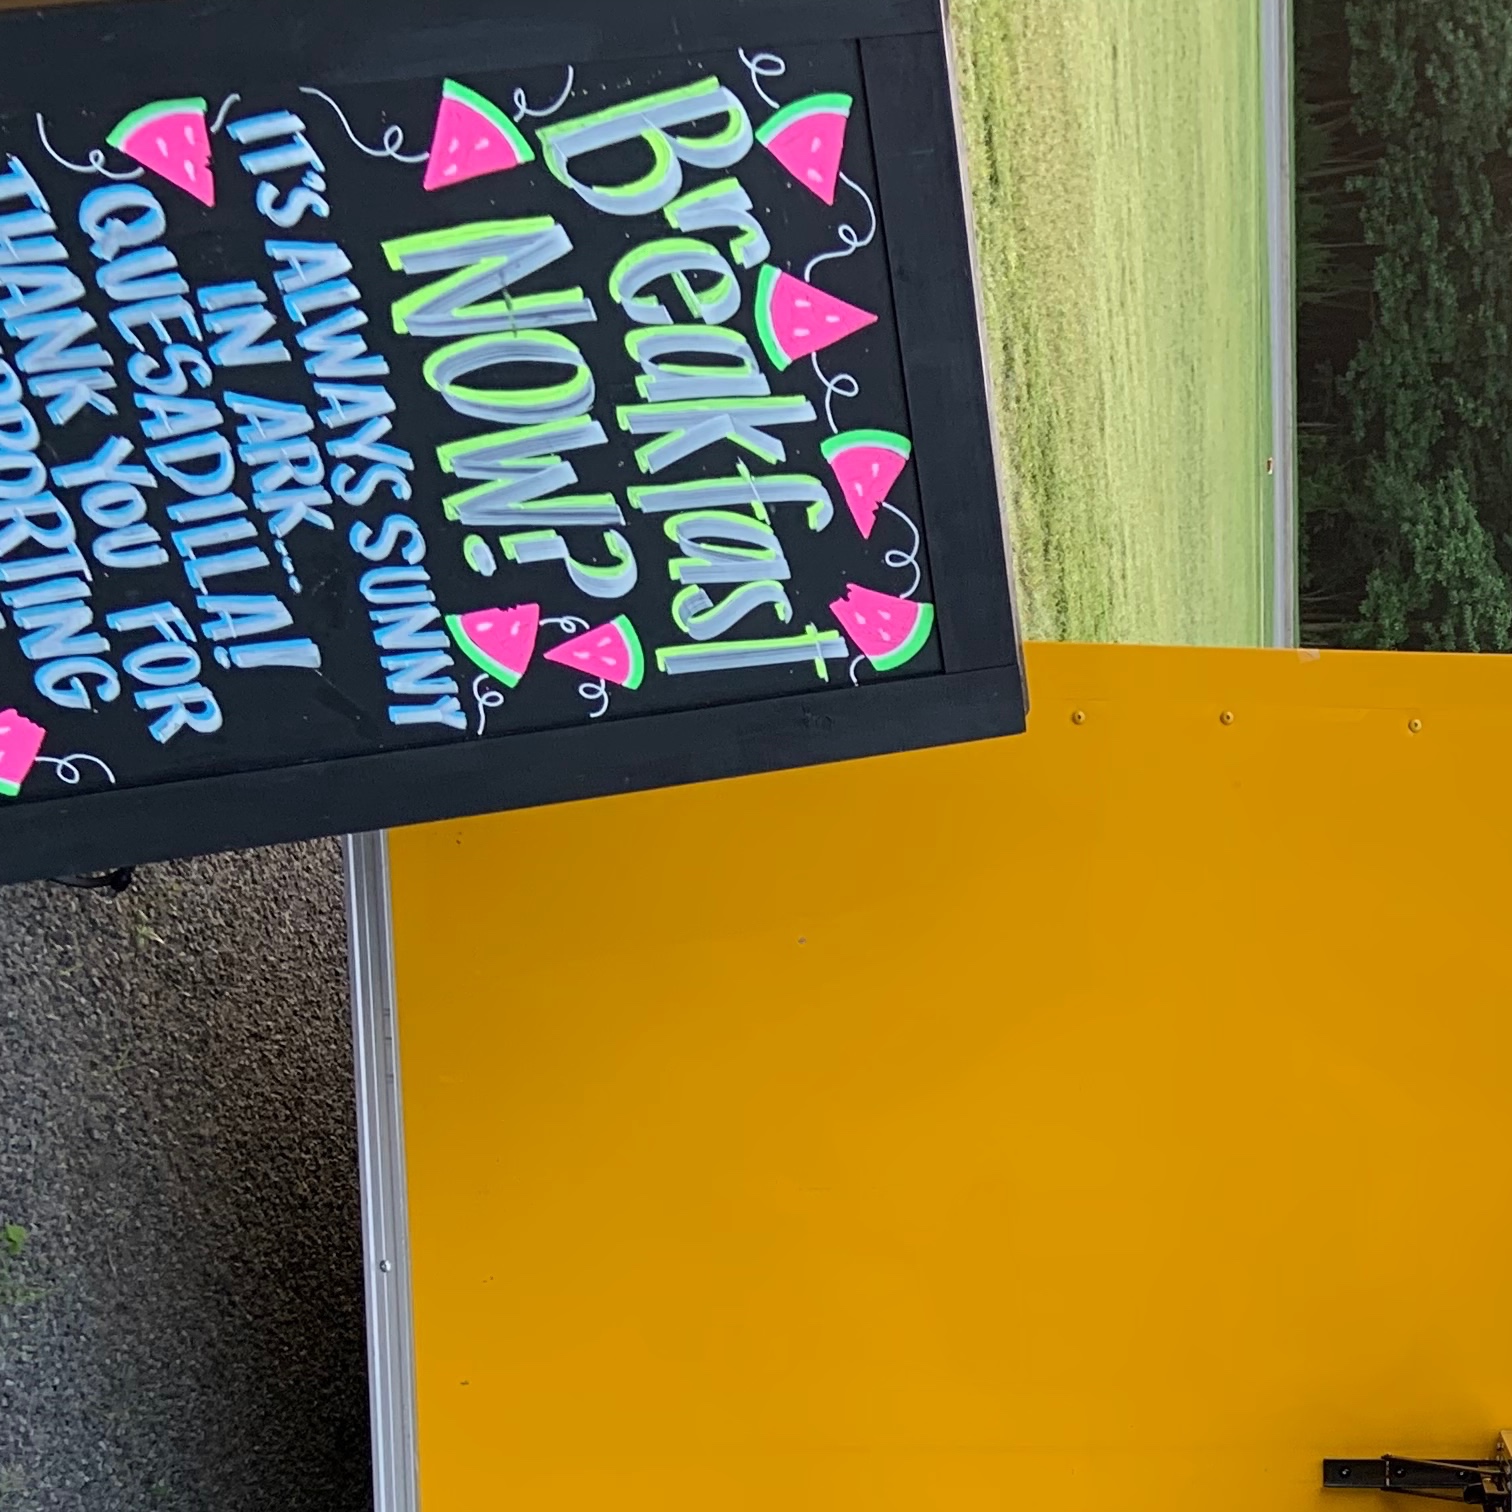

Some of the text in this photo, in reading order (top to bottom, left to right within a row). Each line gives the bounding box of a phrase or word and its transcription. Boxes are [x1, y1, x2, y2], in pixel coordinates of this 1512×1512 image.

[77, 183, 322, 670] QUESADILLA!
[197, 280, 293, 367] IN
[226, 111, 466, 731] IT'S ALWAYS SUNNY
[381, 218, 637, 598] NOW?
[534, 76, 850, 682] Breakfast
[106, 601, 223, 744] FOR
